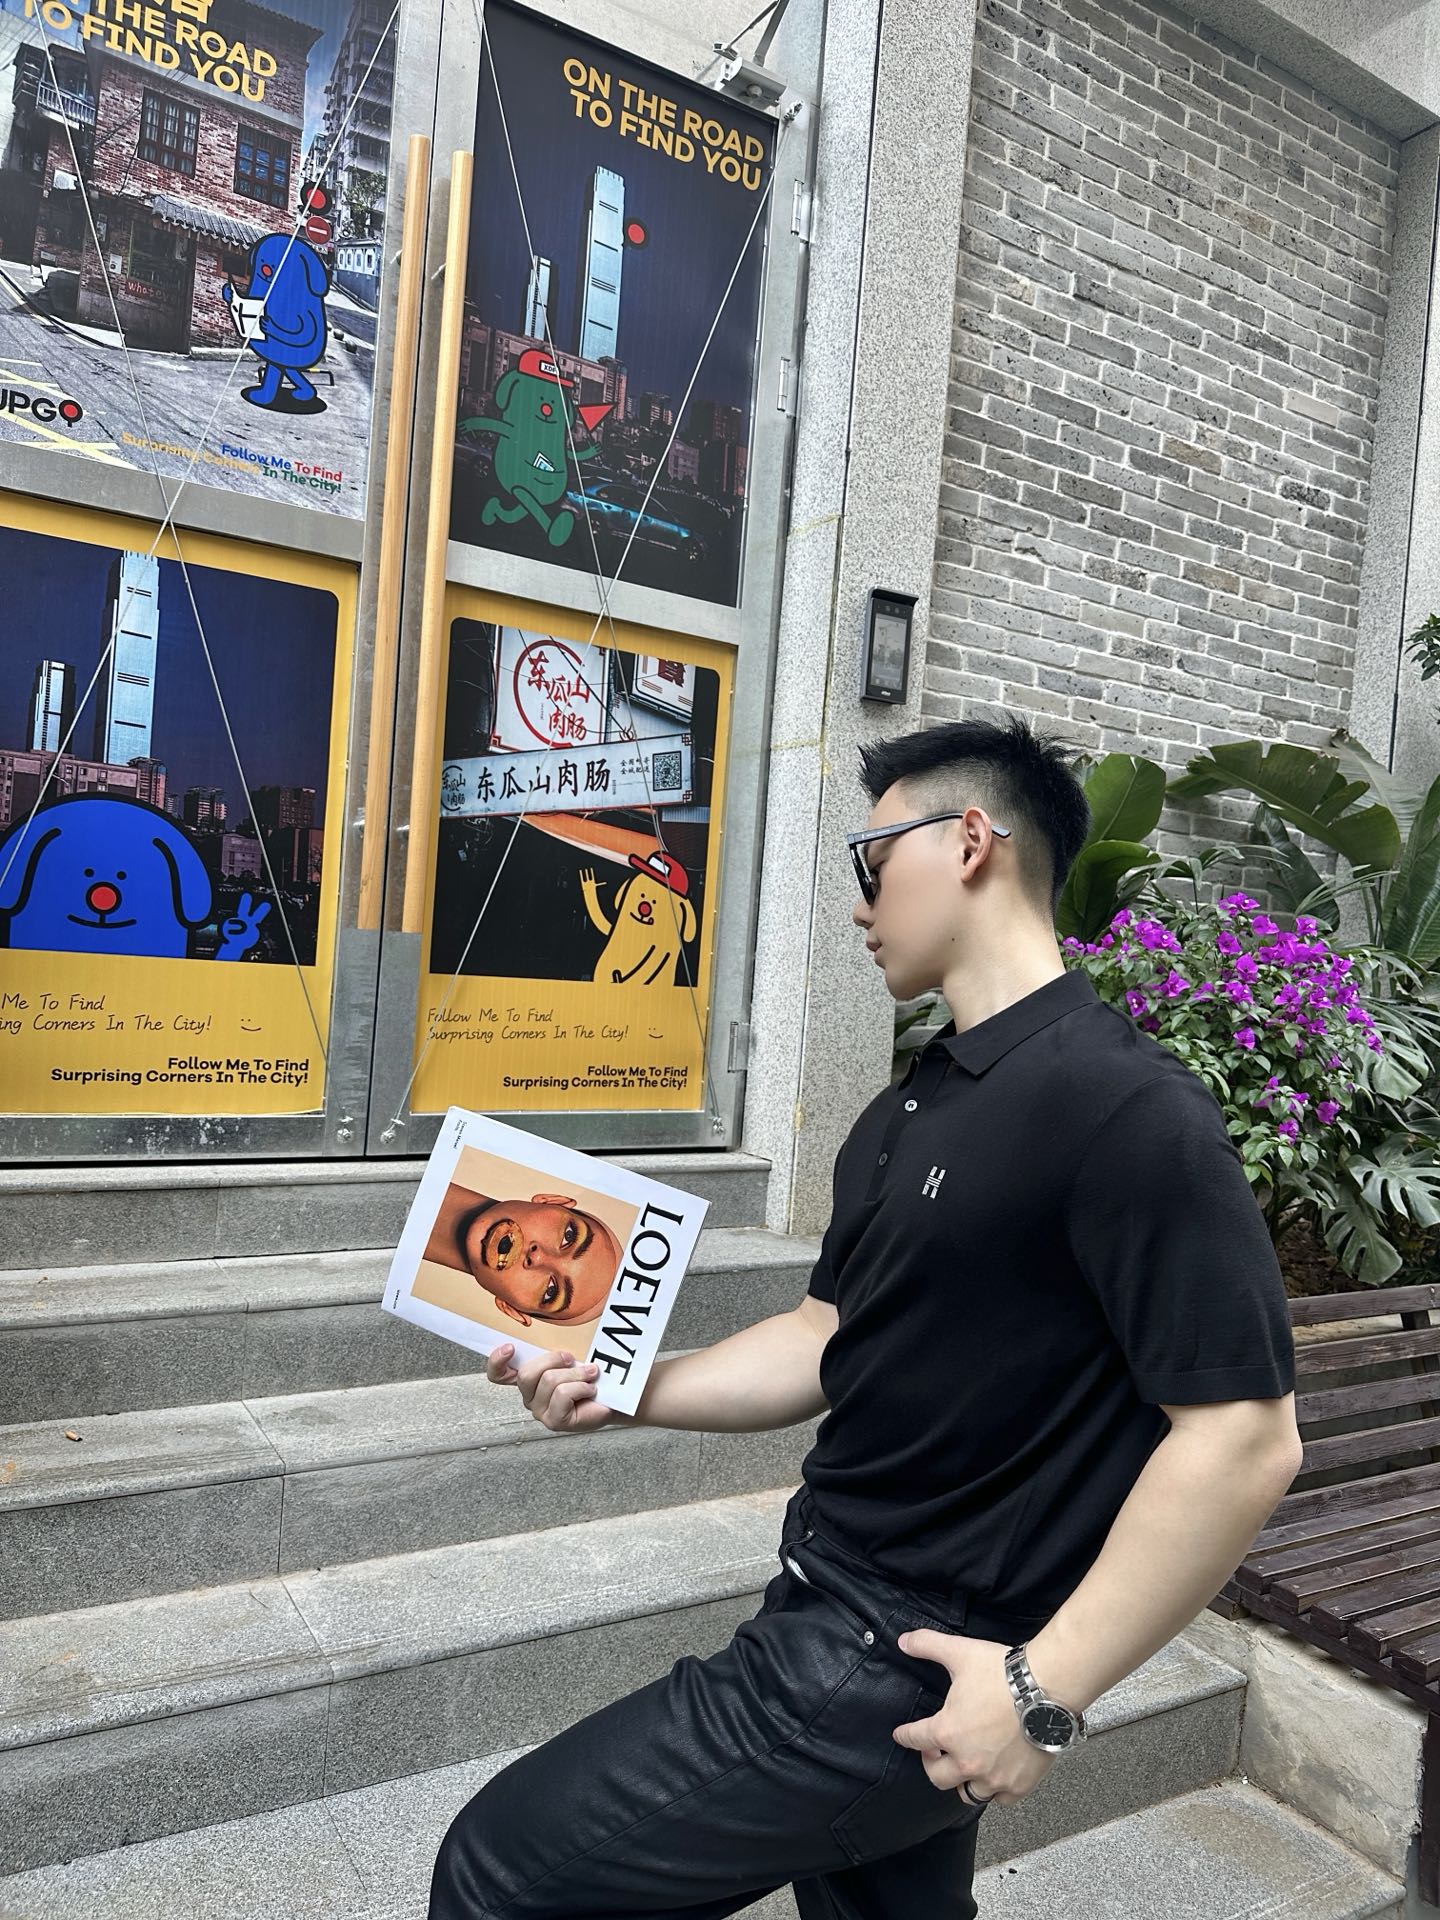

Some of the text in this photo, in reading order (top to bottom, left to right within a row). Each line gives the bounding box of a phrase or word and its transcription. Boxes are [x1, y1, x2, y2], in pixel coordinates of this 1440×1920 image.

[83, 13, 181, 69] FIND
[189, 53, 266, 102] YOU
[175, 19, 277, 78] ROAD
[563, 58, 764, 162] ON THE ROAD
[570, 88, 761, 191] TO FIND YOU
[221, 444, 342, 482] Follow Me To Find
[263, 466, 277, 479] In
[282, 470, 306, 485] The
[310, 477, 342, 494] City!
[528, 650, 590, 708] 东瓜山
[549, 705, 587, 740] 肉肠
[477, 758, 611, 803] 东瓜山肉肠
[2, 993, 105, 1011] Me To Find
[427, 1008, 553, 1022] Follow Me To Find
[33, 1014, 95, 1030] Corners
[106, 1014, 124, 1030] In
[134, 1014, 164, 1030] The
[173, 1015, 211, 1034] City!
[427, 1025, 629, 1043] Surprising Corners In The City!
[51, 1069, 308, 1087] Surprising Corners In The City!
[168, 1057, 309, 1071] Follow Me To Find
[587, 1065, 688, 1077] Follow Me To Find
[503, 1076, 688, 1090] Surprising Corners In The City!
[590, 1202, 684, 1386] LOEWE
